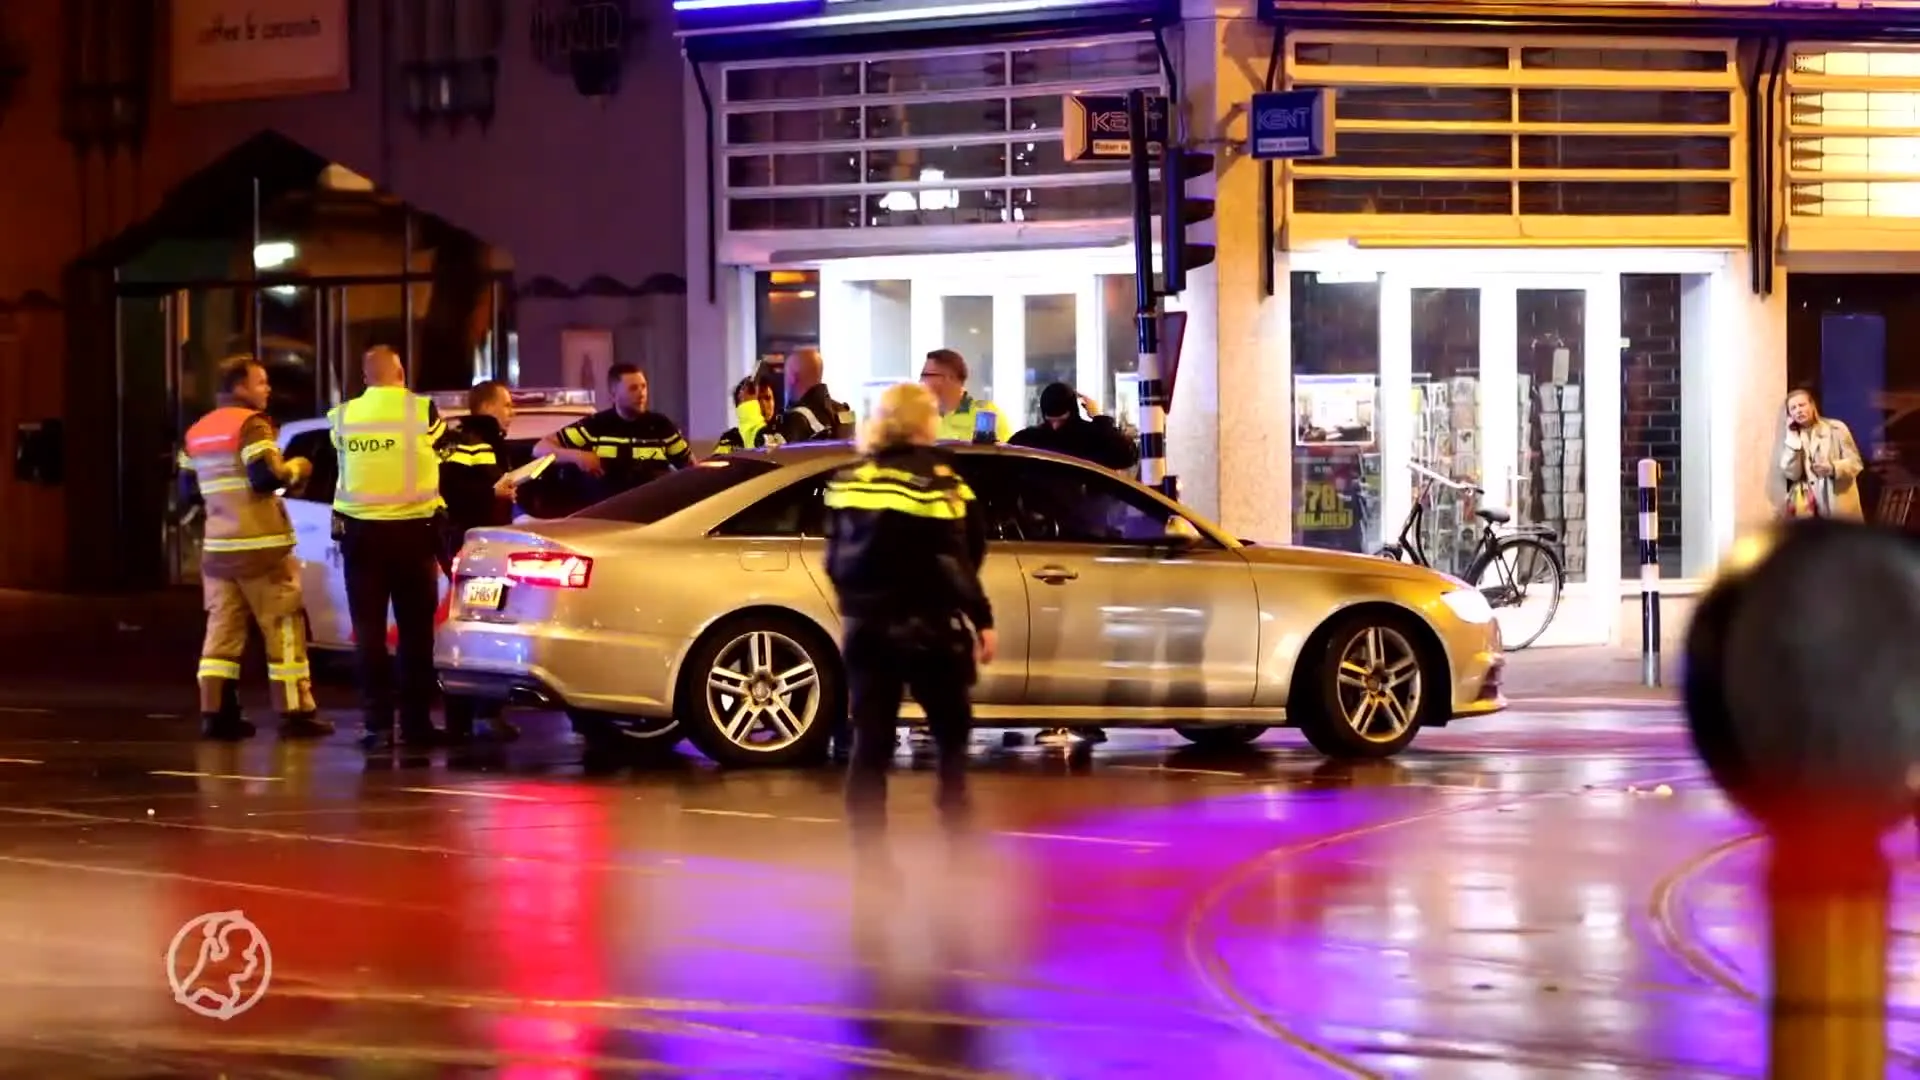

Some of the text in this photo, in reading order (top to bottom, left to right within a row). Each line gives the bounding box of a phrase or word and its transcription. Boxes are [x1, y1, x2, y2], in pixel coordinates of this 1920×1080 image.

[1091, 111, 1163, 132] KET
[1256, 107, 1311, 132] KENT
[348, 438, 396, 453] OVD-P
